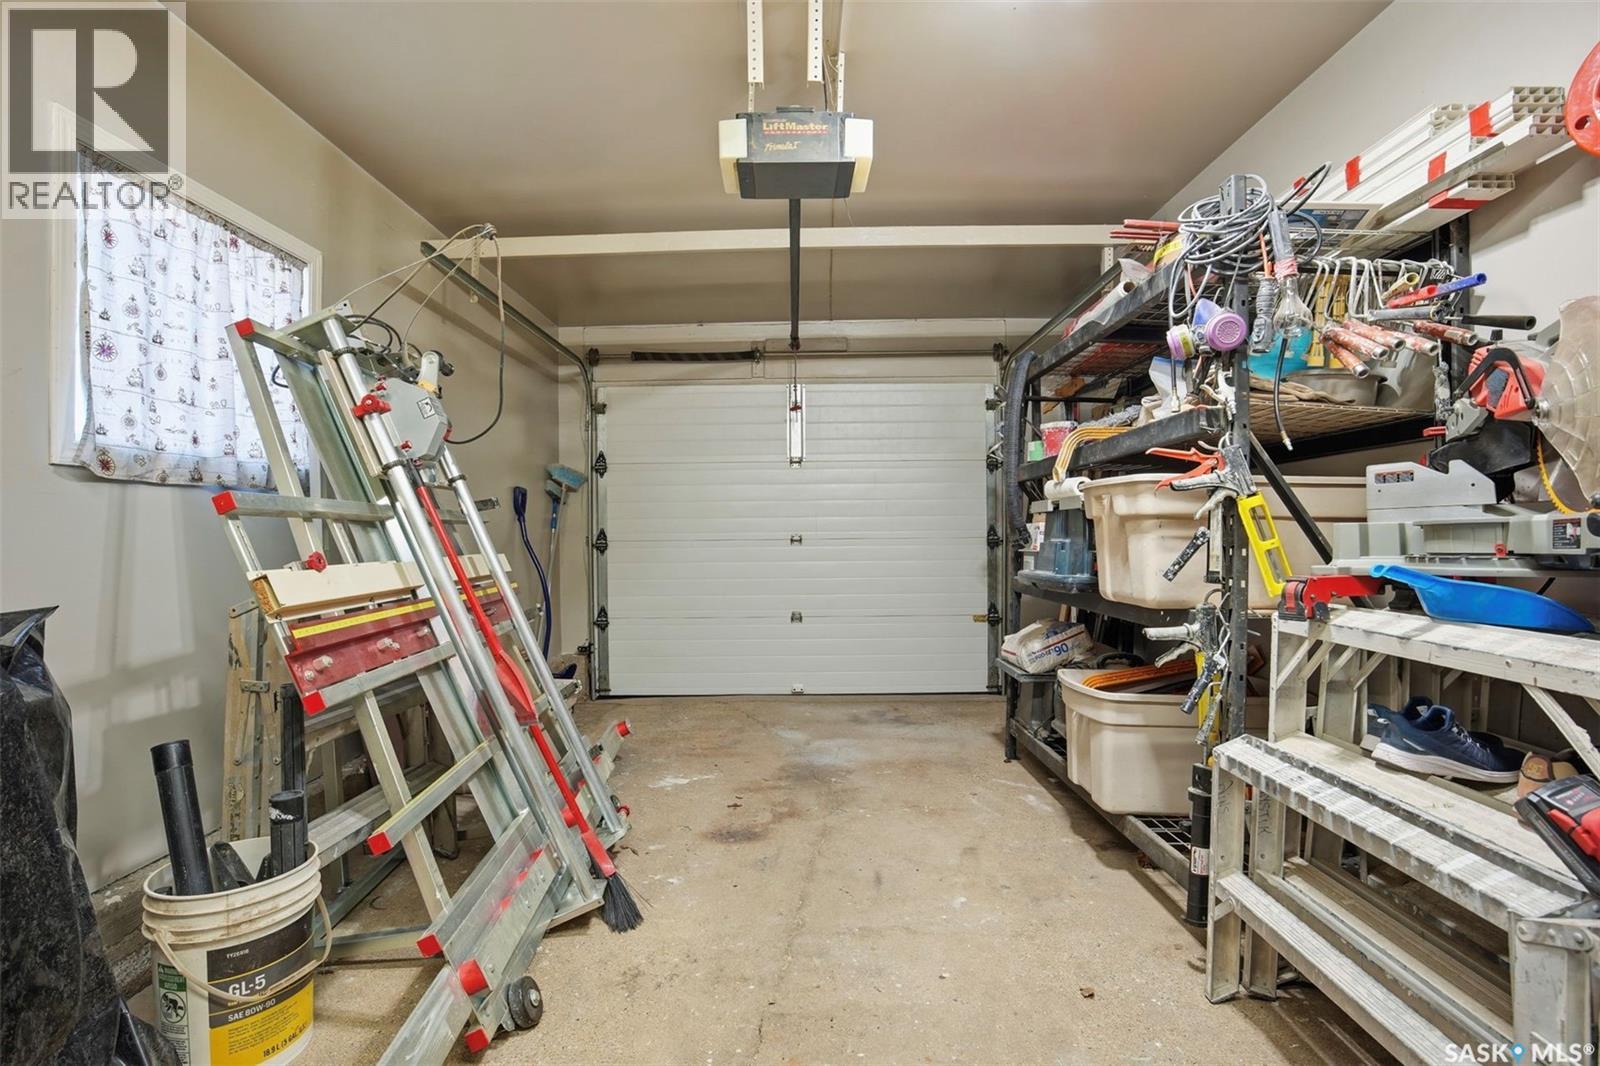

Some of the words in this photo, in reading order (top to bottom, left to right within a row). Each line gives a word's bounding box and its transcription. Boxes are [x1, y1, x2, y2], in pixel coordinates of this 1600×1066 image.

[763, 122, 829, 131] LiftMaster
[1054, 642, 1069, 657] 90
[228, 973, 267, 998] GL-5
[228, 1011, 245, 1022] SAE
